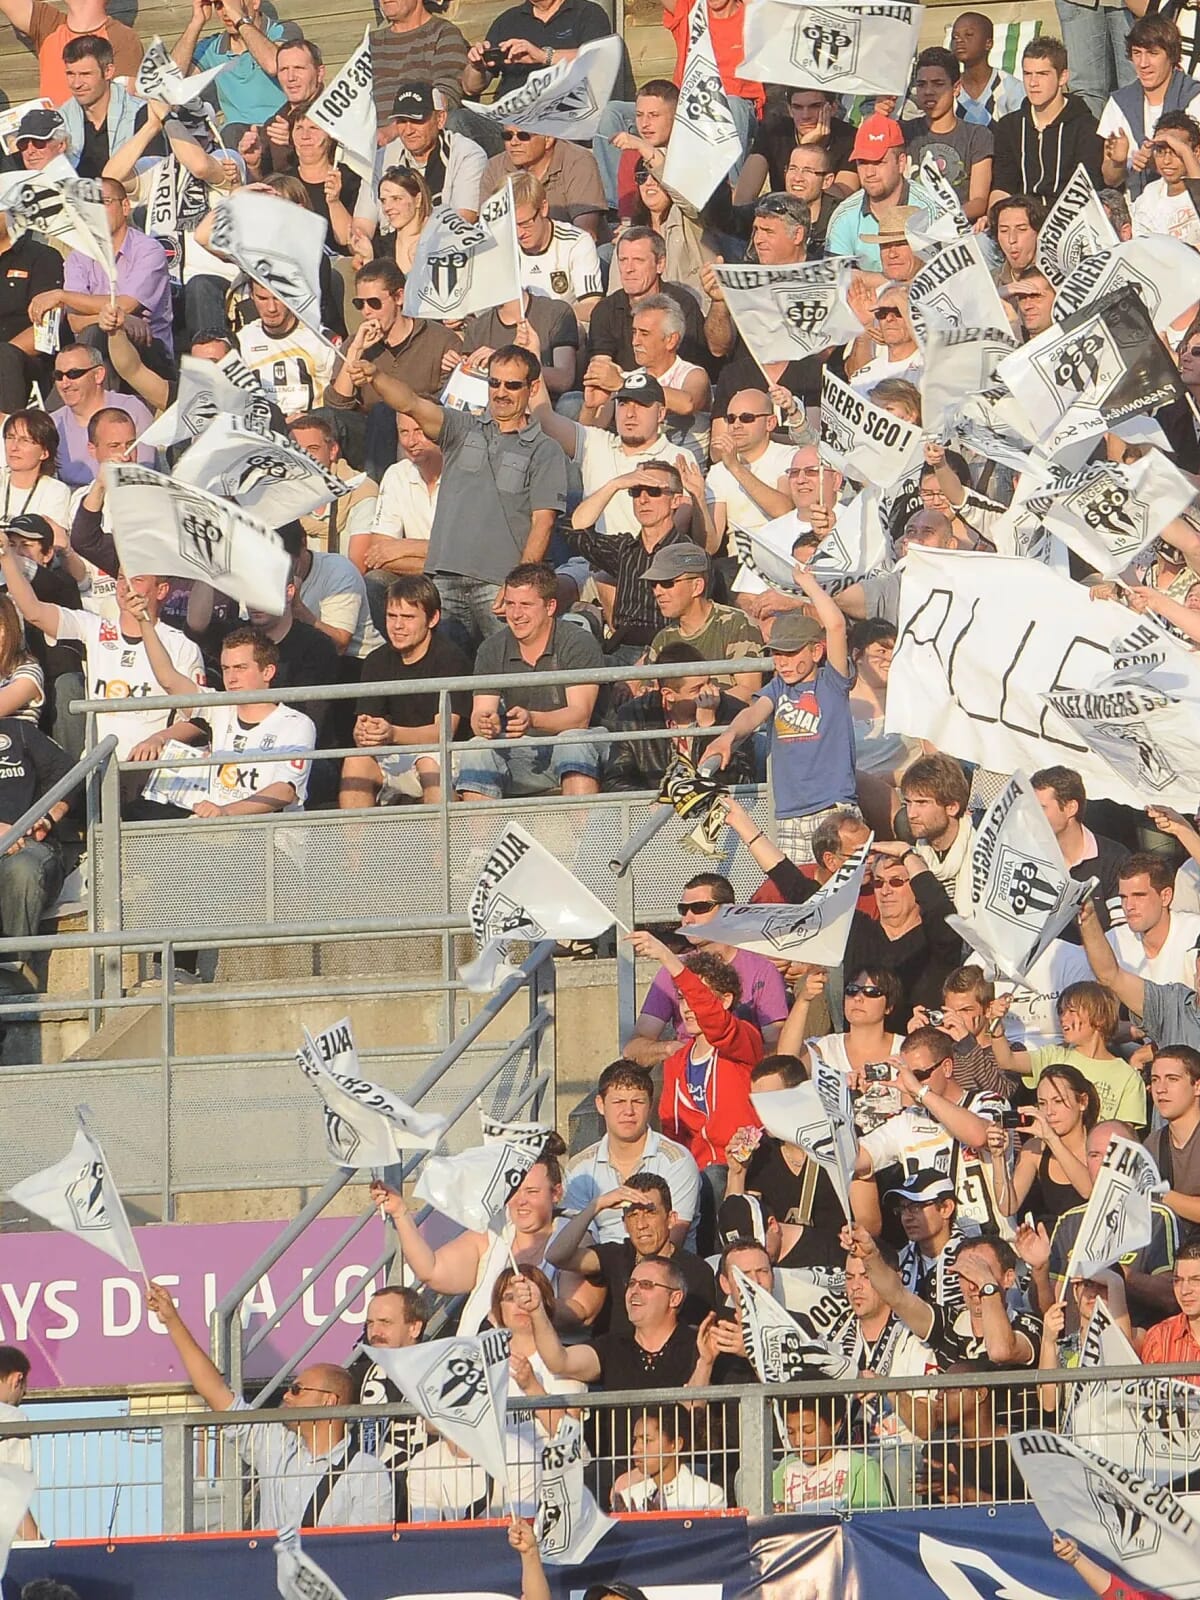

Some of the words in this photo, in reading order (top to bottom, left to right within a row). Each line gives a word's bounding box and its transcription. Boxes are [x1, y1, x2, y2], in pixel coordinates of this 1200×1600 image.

[787, 291, 830, 301] ANGERS
[1066, 250, 1112, 312] ANGERS
[788, 306, 827, 322] SCO
[822, 375, 865, 426] NGERS
[1075, 473, 1115, 511] ANGERS
[1086, 489, 1126, 526] SCO
[1085, 690, 1139, 720] ANGERS
